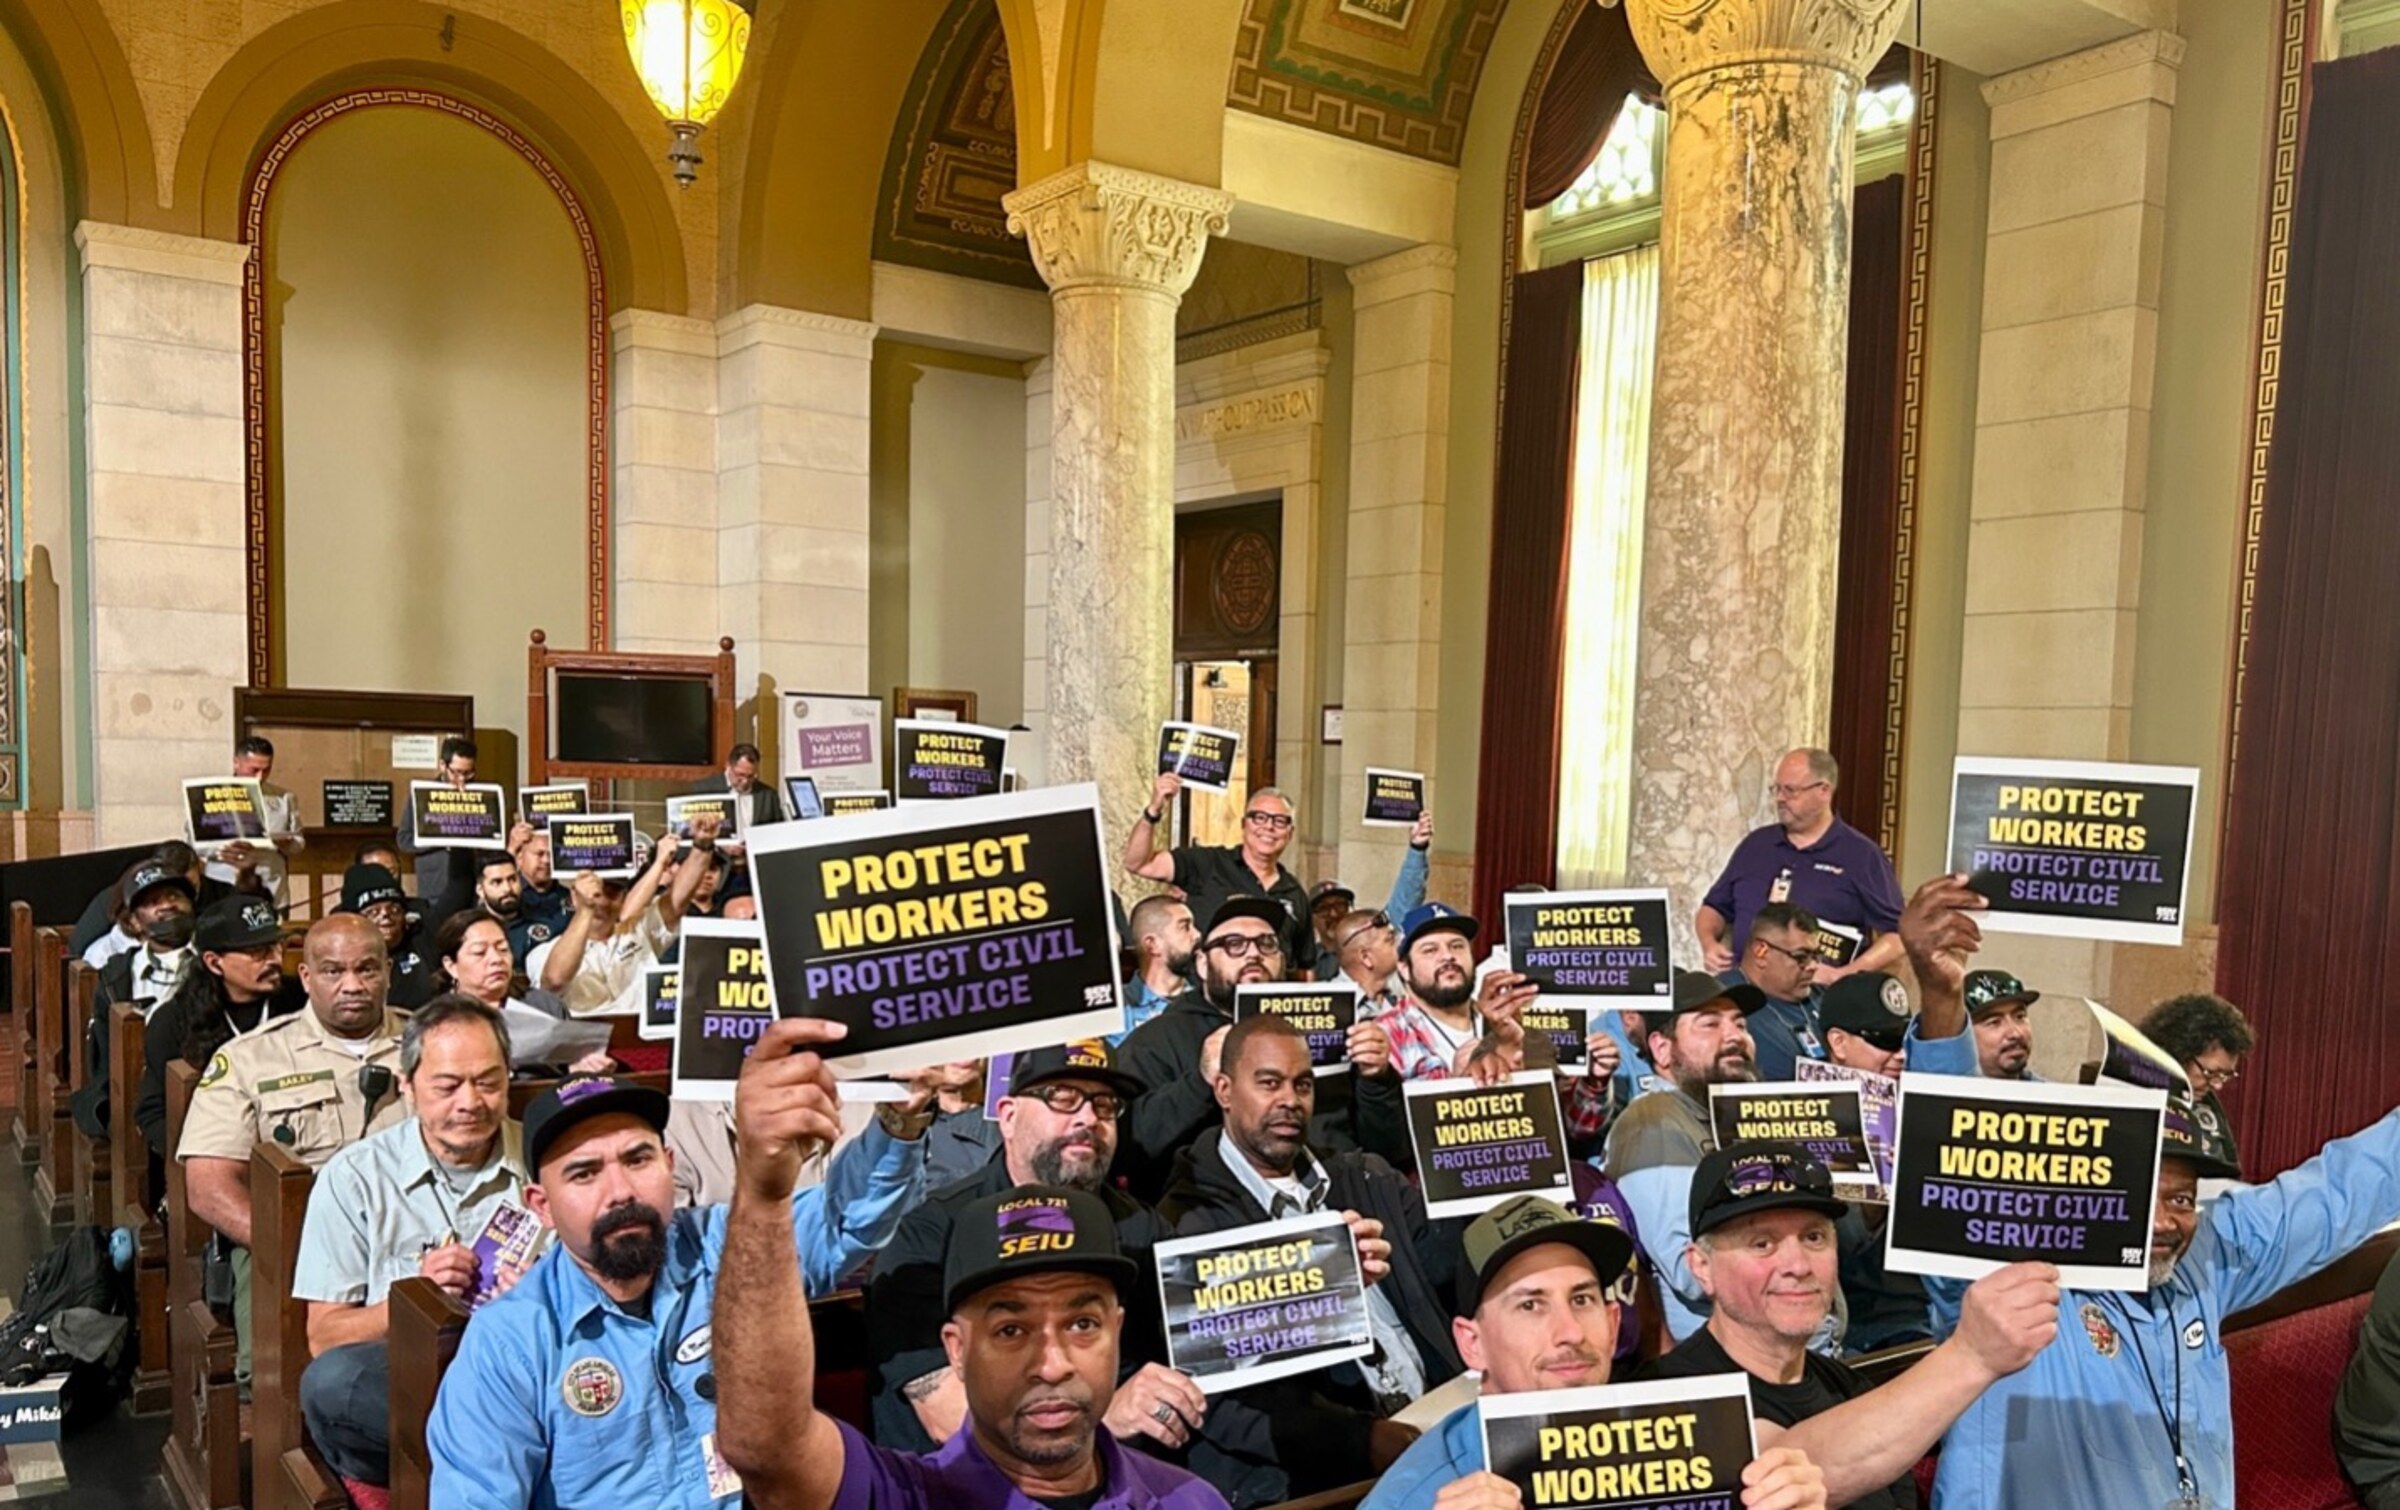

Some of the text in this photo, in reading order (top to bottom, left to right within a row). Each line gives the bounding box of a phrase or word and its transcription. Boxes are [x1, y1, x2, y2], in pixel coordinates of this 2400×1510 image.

[806, 729, 862, 743] Your Voice
[919, 734, 983, 751] PROTECT
[811, 743, 862, 756] Matters
[915, 749, 985, 768] WORKERS
[909, 766, 961, 780] PROTECT
[428, 801, 487, 814] WORKERS
[430, 791, 483, 802] PROTECT
[1998, 785, 2144, 818] PROTECT
[563, 835, 618, 846] WORKERS
[565, 824, 615, 834] PROTECT
[1988, 817, 2147, 851] WORKERS
[820, 833, 1030, 899] PROTECT
[1973, 851, 2163, 883] PROTECT CIVIL
[2010, 879, 2120, 906] SERVICE
[815, 881, 1049, 950] WORKERS
[1537, 907, 1635, 926] PROTECT
[1533, 927, 1642, 947] WORKERS
[805, 945, 971, 1000] PROTECT
[978, 927, 1085, 972] CIVIL
[1526, 951, 1657, 967] PROTECT CIVIL
[1554, 970, 1629, 985] SERVICE
[872, 974, 1031, 1029] SERVICE
[1260, 997, 1332, 1013] PROTECT
[703, 1016, 770, 1039] PROT
[1522, 1016, 1570, 1029] RKERS
[1066, 1054, 1108, 1068] SEIU
[1436, 1093, 1524, 1121] PROTECT
[1740, 1099, 1831, 1119] PROTECT
[1435, 1117, 1534, 1146] WORKERS
[1737, 1121, 1837, 1139] WORKERS
[1951, 1108, 2110, 1147] PROTECT
[1432, 1141, 1552, 1170] PROTECT CIVIL
[1806, 1141, 1854, 1154] CIVIL
[1461, 1165, 1531, 1188] SERVICE
[1940, 1145, 2113, 1186] WORKERS
[997, 1197, 1069, 1213] LOCAL 721
[1921, 1183, 2130, 1221] PROTECT CIVIL
[998, 1233, 1075, 1258] SEIU
[1965, 1219, 2086, 1249] SERVICE
[1196, 1239, 1313, 1282] PROTECT
[1193, 1267, 1325, 1312] WORKERS
[1188, 1295, 1347, 1340] PROTECT CIVIL
[1223, 1325, 1318, 1358] SERVICE
[1538, 1414, 1697, 1461] PROTECT
[1532, 1456, 1714, 1504] WORKERS
